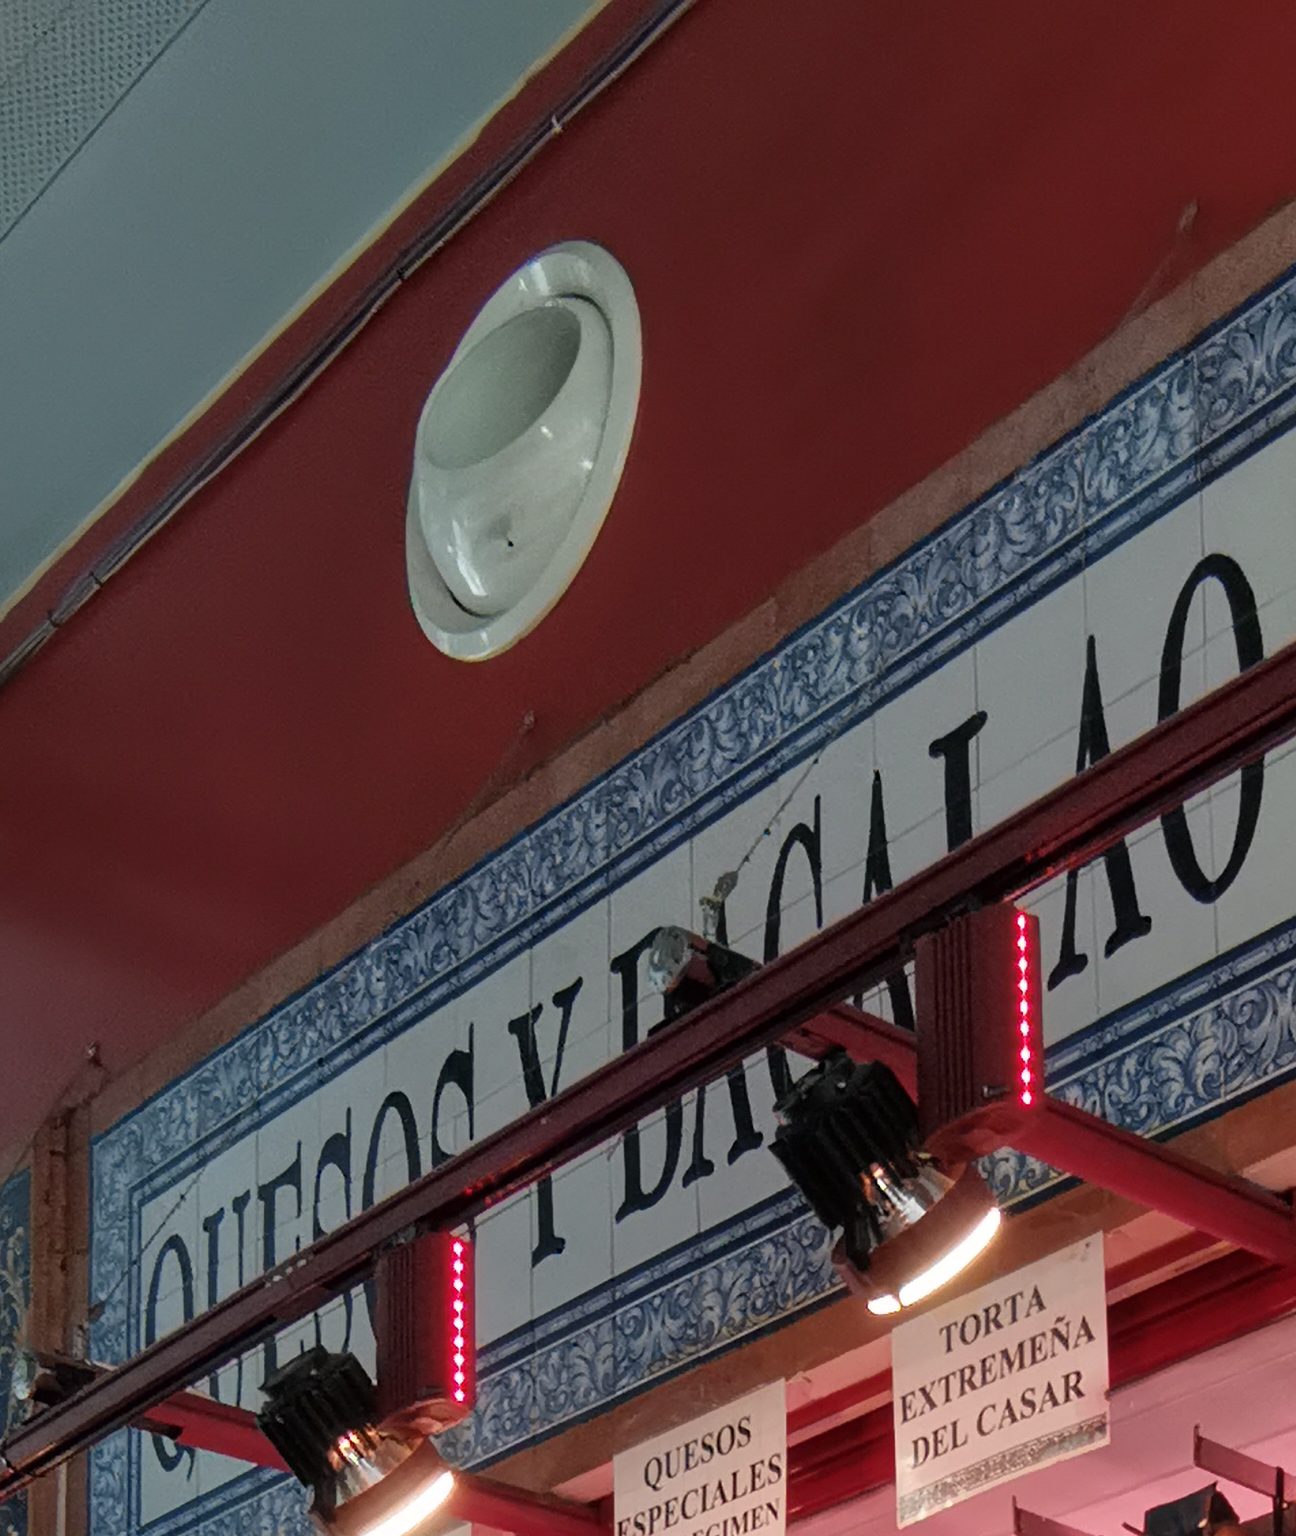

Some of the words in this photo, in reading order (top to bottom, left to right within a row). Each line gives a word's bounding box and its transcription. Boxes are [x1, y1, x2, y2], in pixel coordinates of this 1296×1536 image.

[508, 976, 585, 1268] Y
[901, 1314, 1095, 1424] EXTREMEÑA
[939, 1285, 1047, 1354] TORTA
[644, 1415, 752, 1491] QUESOS
[912, 1414, 968, 1470] DEL
[976, 1369, 1085, 1436] CASAR
